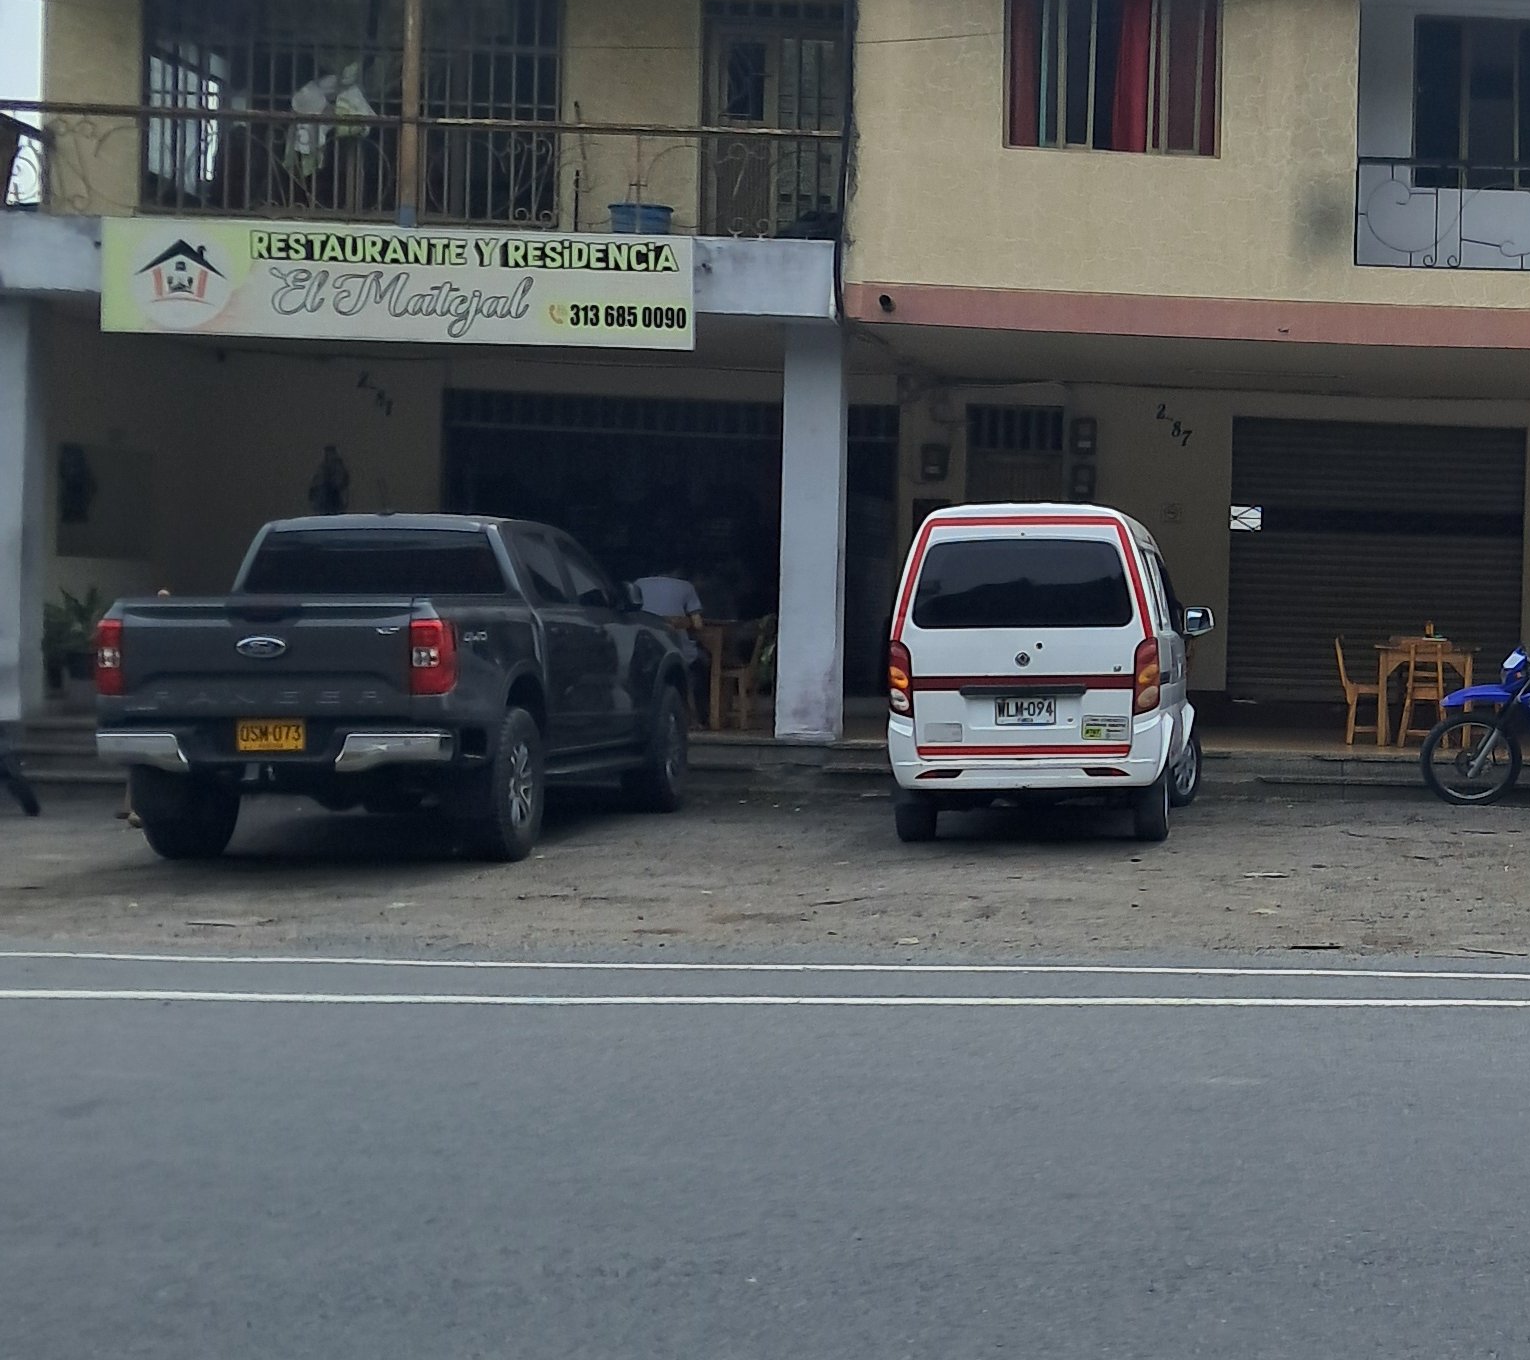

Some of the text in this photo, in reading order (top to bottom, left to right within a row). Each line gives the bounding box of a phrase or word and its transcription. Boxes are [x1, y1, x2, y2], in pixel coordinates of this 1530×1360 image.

[250, 230, 468, 266] RESTAURANTE
[475, 238, 500, 267] Y
[270, 268, 329, 316] El
[569, 304, 687, 329] 313 685 0090
[997, 701, 1054, 718] WLM-094
